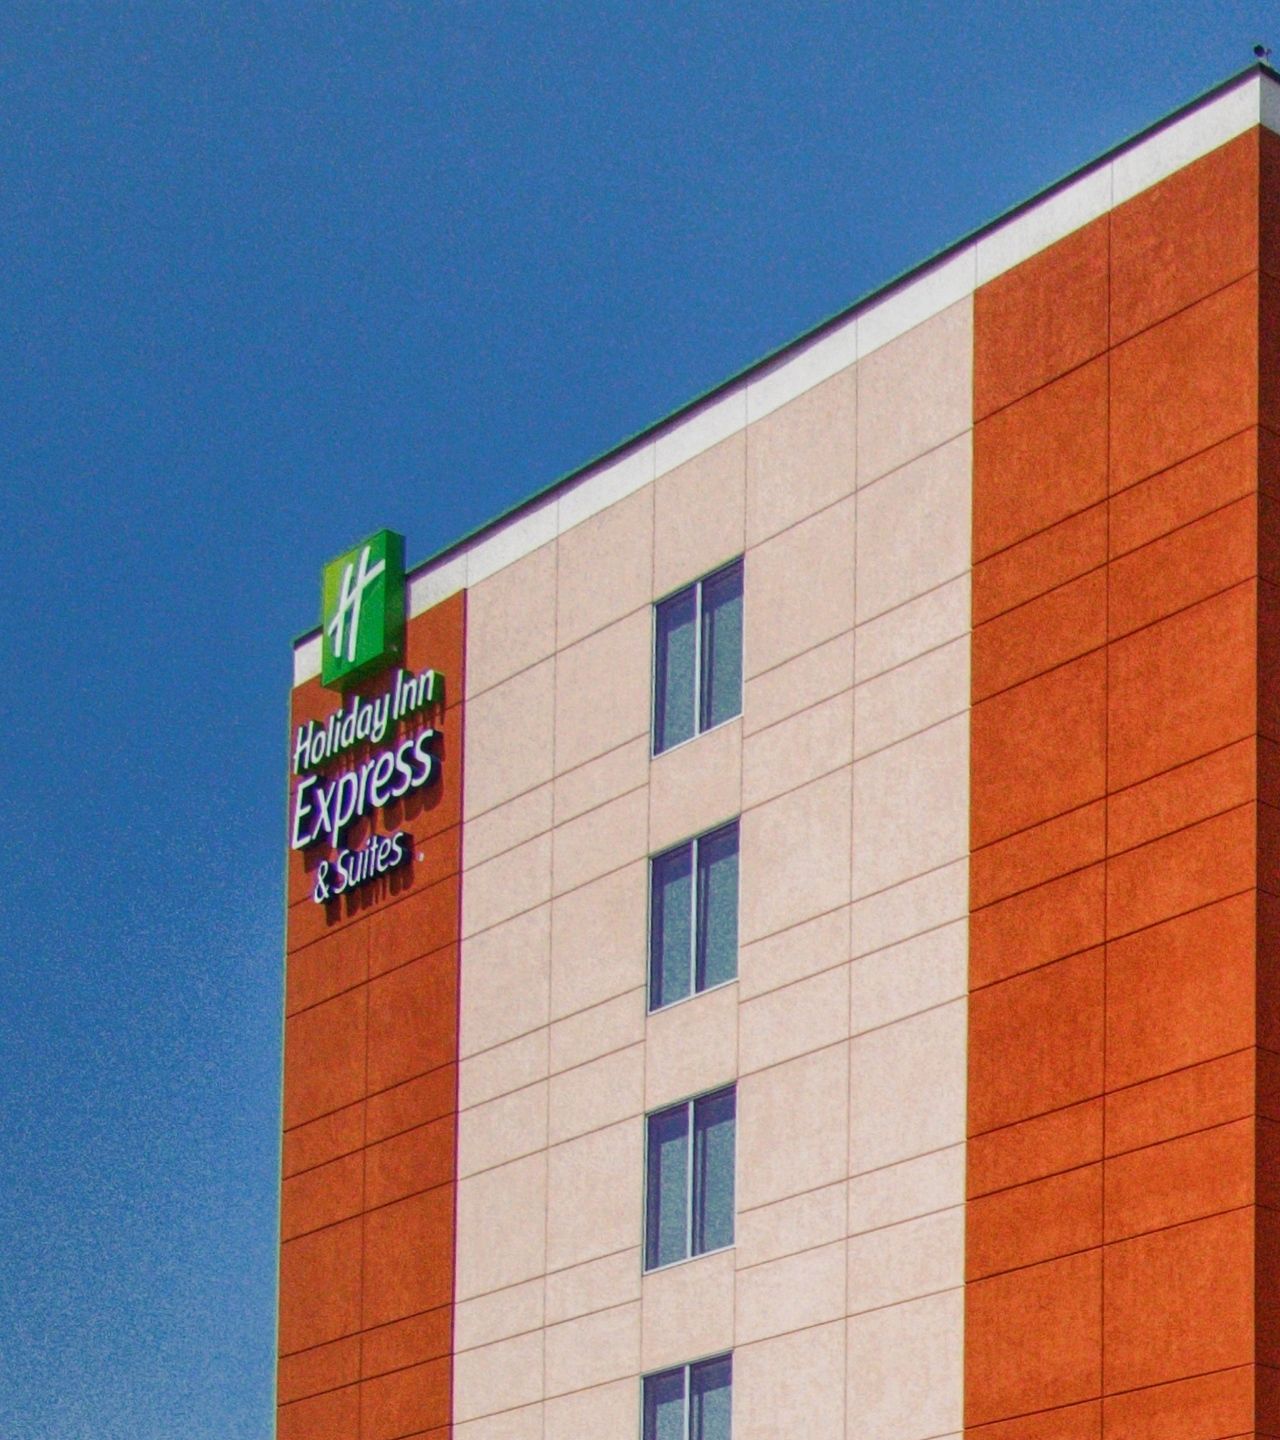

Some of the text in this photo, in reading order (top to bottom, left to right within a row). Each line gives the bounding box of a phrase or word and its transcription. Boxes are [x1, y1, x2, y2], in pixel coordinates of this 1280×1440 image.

[293, 669, 435, 775] Holiday Inn
[291, 729, 434, 850] Express
[313, 832, 404, 904] & Suites
